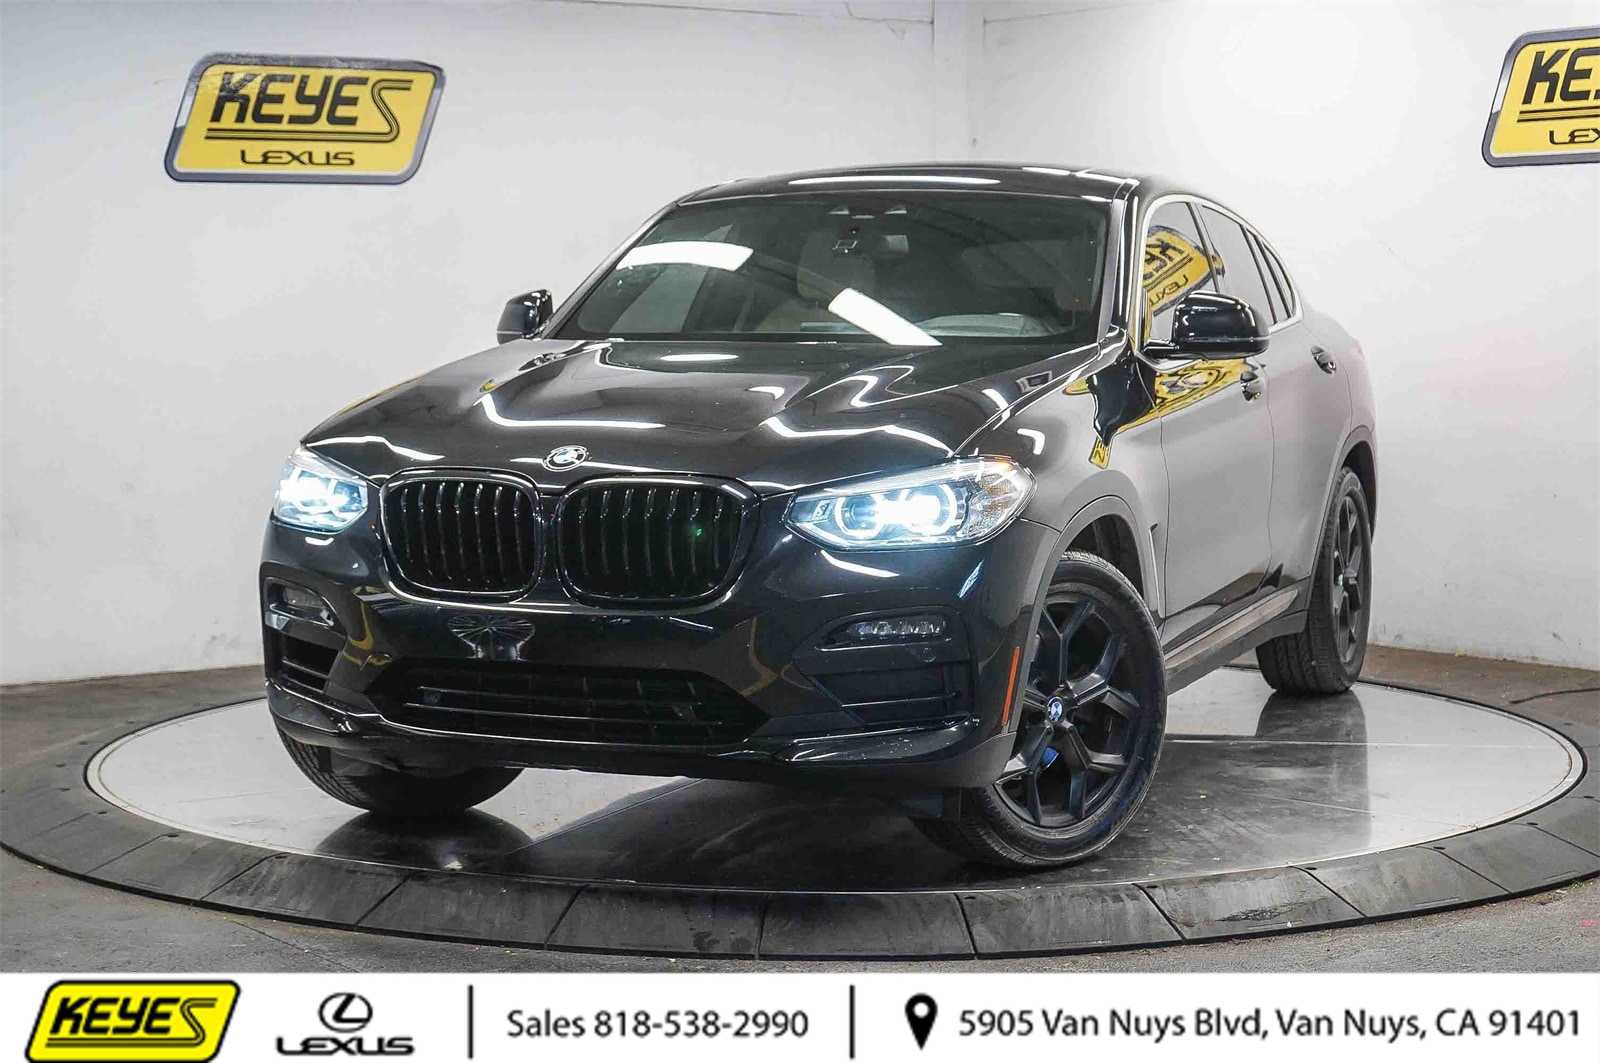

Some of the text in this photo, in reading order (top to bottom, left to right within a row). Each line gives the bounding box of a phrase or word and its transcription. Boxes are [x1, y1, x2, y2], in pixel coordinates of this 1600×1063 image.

[1520, 46, 1600, 105] KE
[206, 71, 414, 142] KEYES
[240, 149, 354, 166] LEXUS
